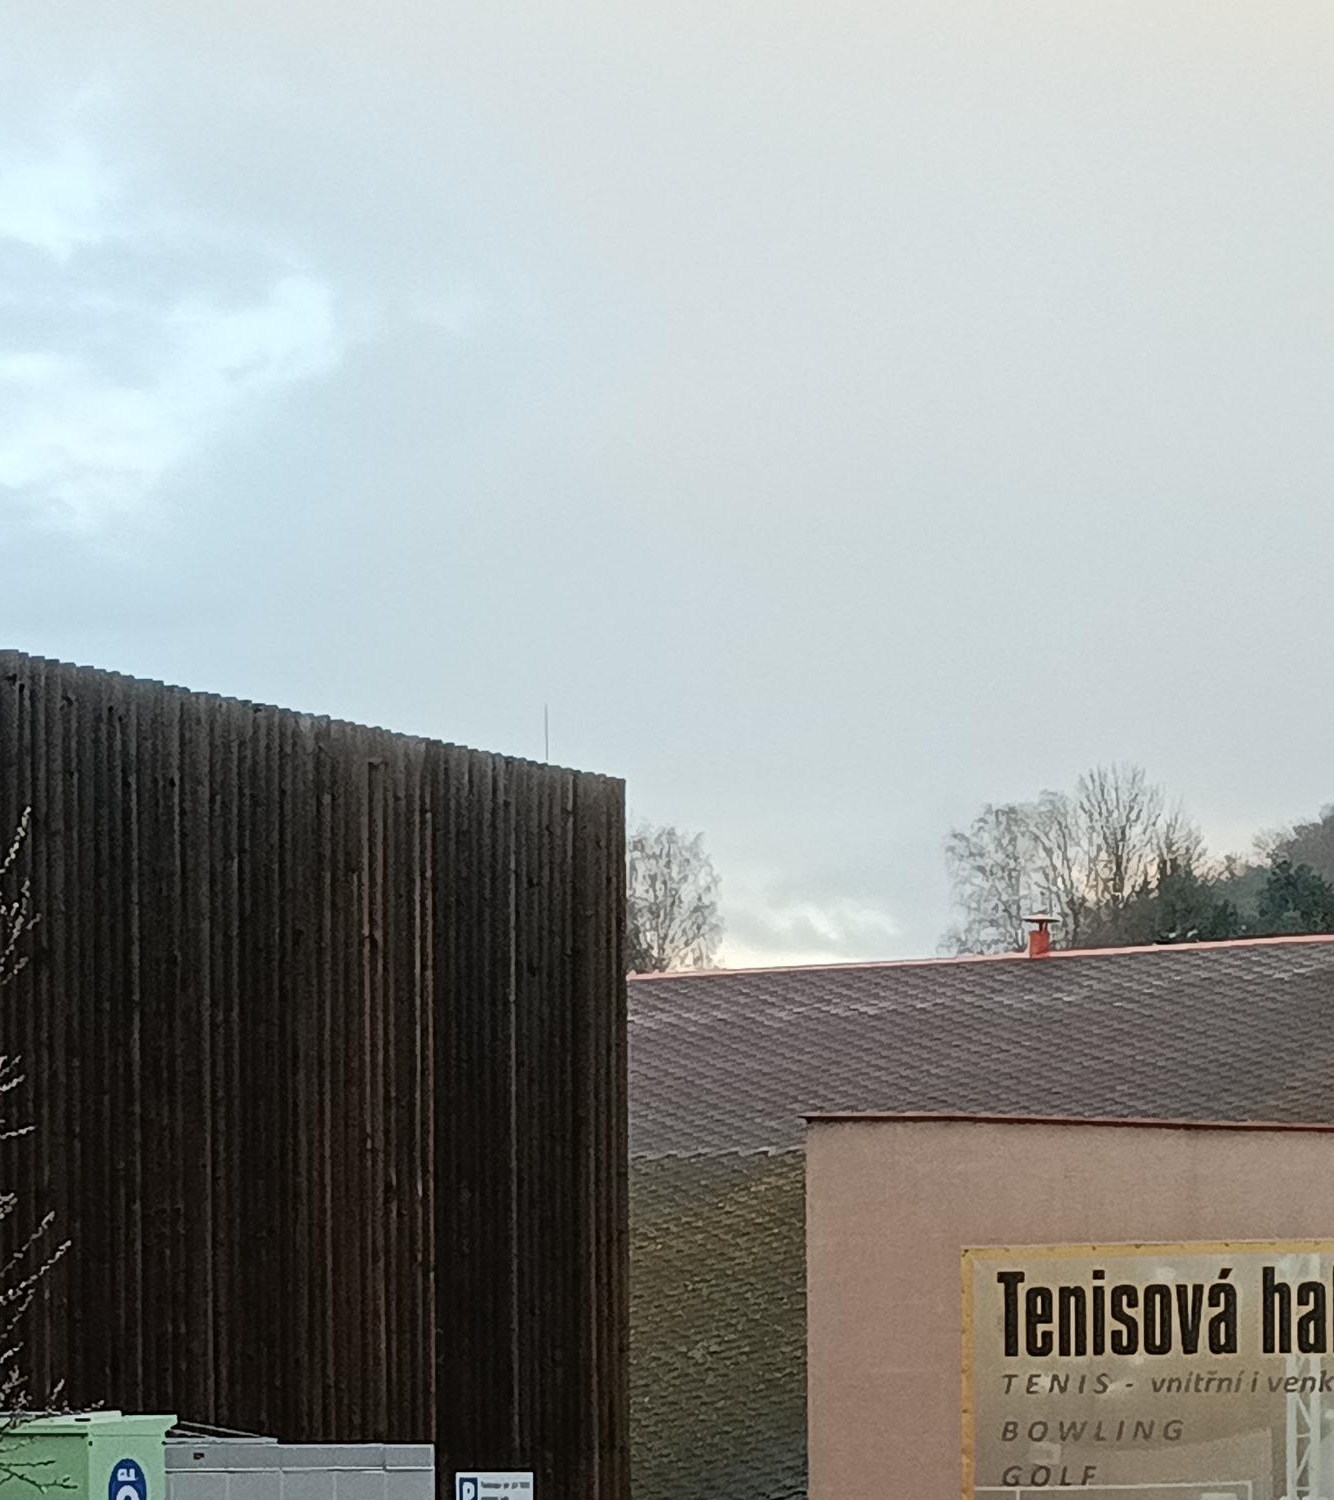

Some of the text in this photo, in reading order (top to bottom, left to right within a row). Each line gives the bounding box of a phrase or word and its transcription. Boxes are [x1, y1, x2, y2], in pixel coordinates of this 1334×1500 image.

[997, 1267, 1237, 1357] Tenisová
[1003, 1373, 1111, 1395] TENIS
[1001, 1419, 1184, 1442] BOWLING
[1002, 1465, 1097, 1488] GOLF
